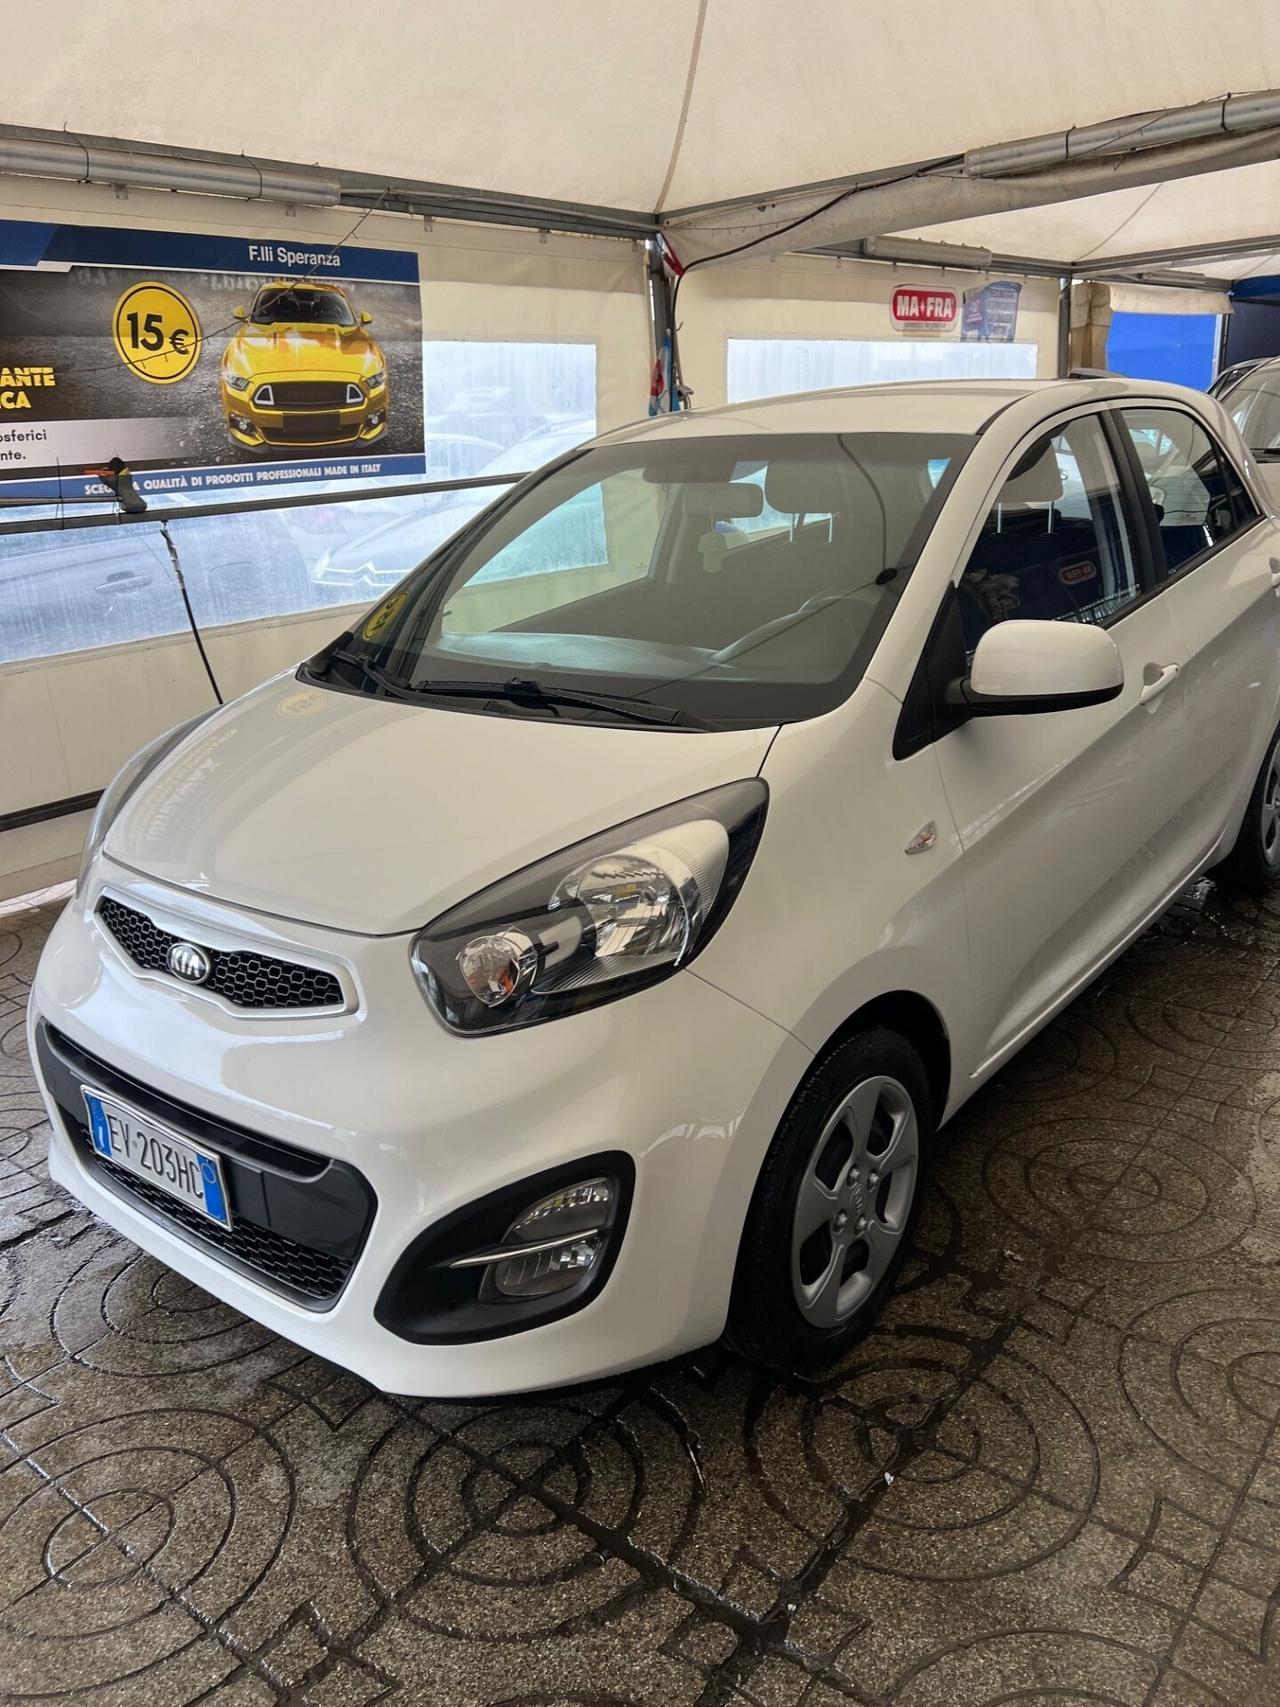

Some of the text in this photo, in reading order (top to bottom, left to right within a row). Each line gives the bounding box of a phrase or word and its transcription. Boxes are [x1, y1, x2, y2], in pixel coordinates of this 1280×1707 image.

[248, 245, 341, 267] F.lli Speranza
[0, 391, 32, 410] CA
[143, 475, 188, 491] QUALITÀ
[191, 476, 202, 487] DI
[205, 471, 254, 486] PRODOTTI
[256, 467, 322, 481] PROFESSIONALI
[324, 465, 348, 476] MADE
[350, 466, 359, 475] IN
[361, 463, 381, 474] ITALY
[170, 947, 201, 978] KIA
